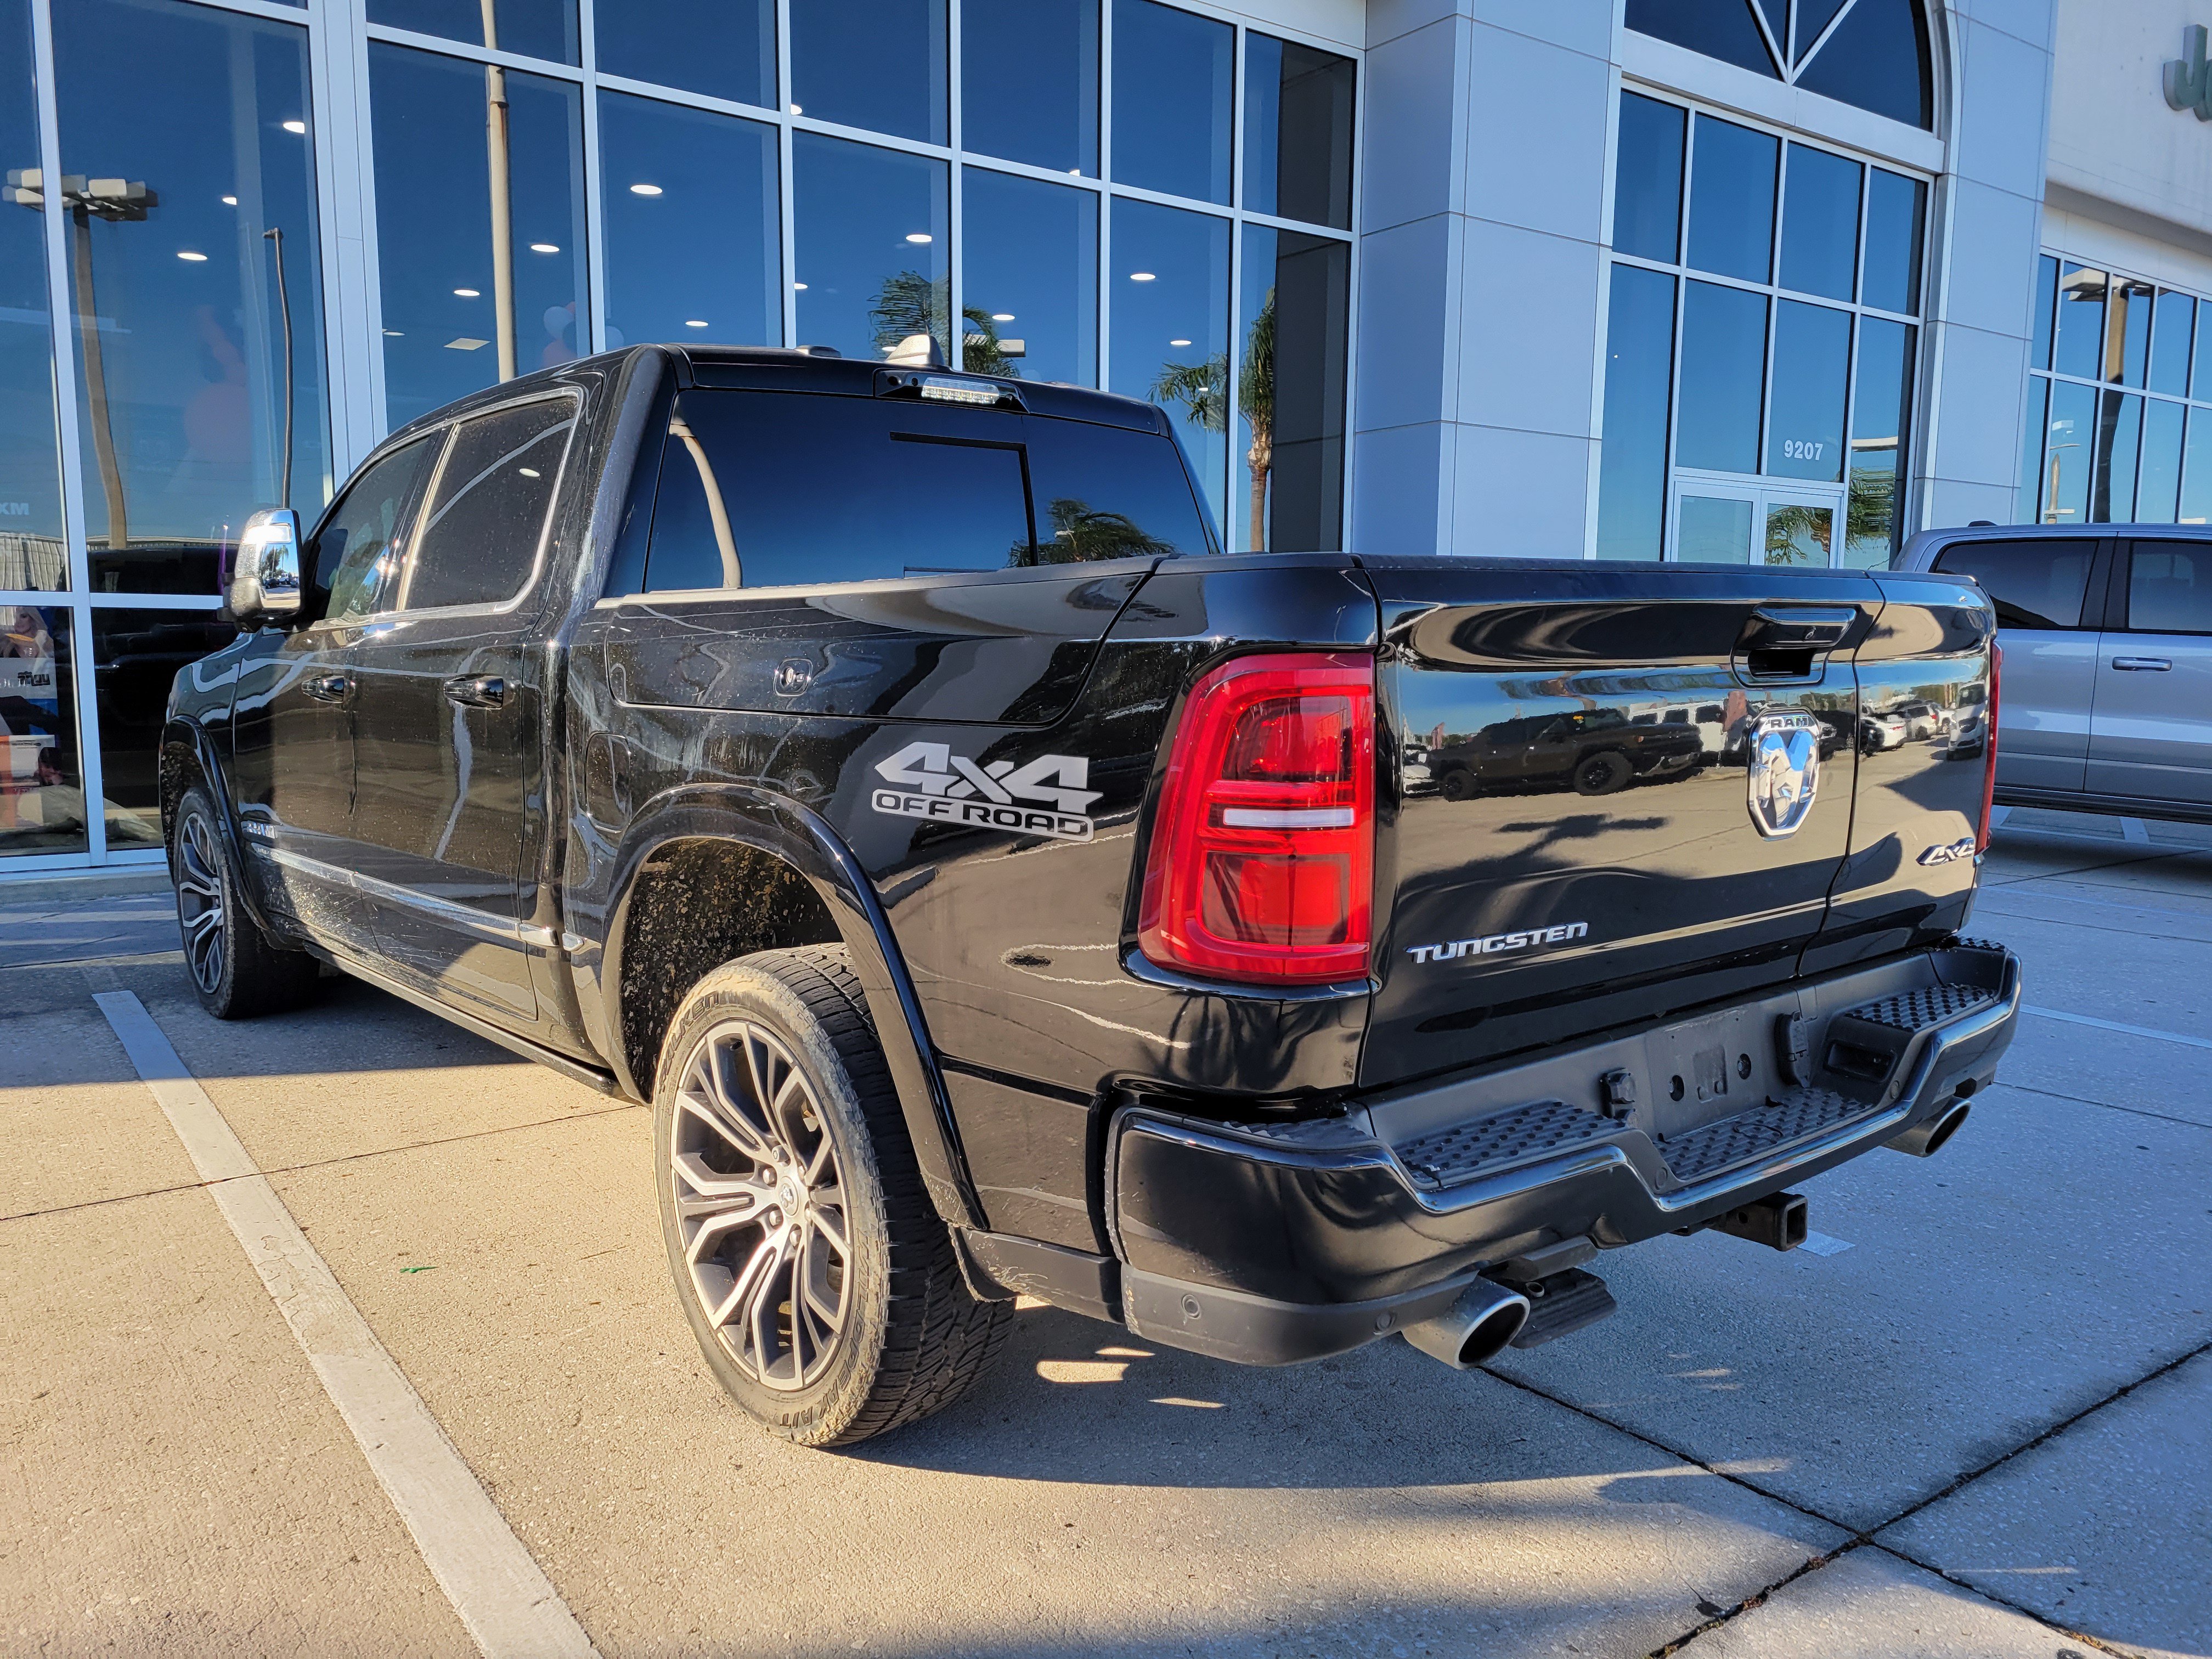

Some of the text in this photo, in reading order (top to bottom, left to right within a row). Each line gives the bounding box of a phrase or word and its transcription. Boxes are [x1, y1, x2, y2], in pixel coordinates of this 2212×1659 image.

[1784, 439, 1824, 461] 9207
[1770, 715, 1809, 729] RAM
[874, 741, 1104, 814] 4X4
[877, 792, 1089, 836] OFF ROAD
[1404, 921, 1589, 964] TUNGSTEN
